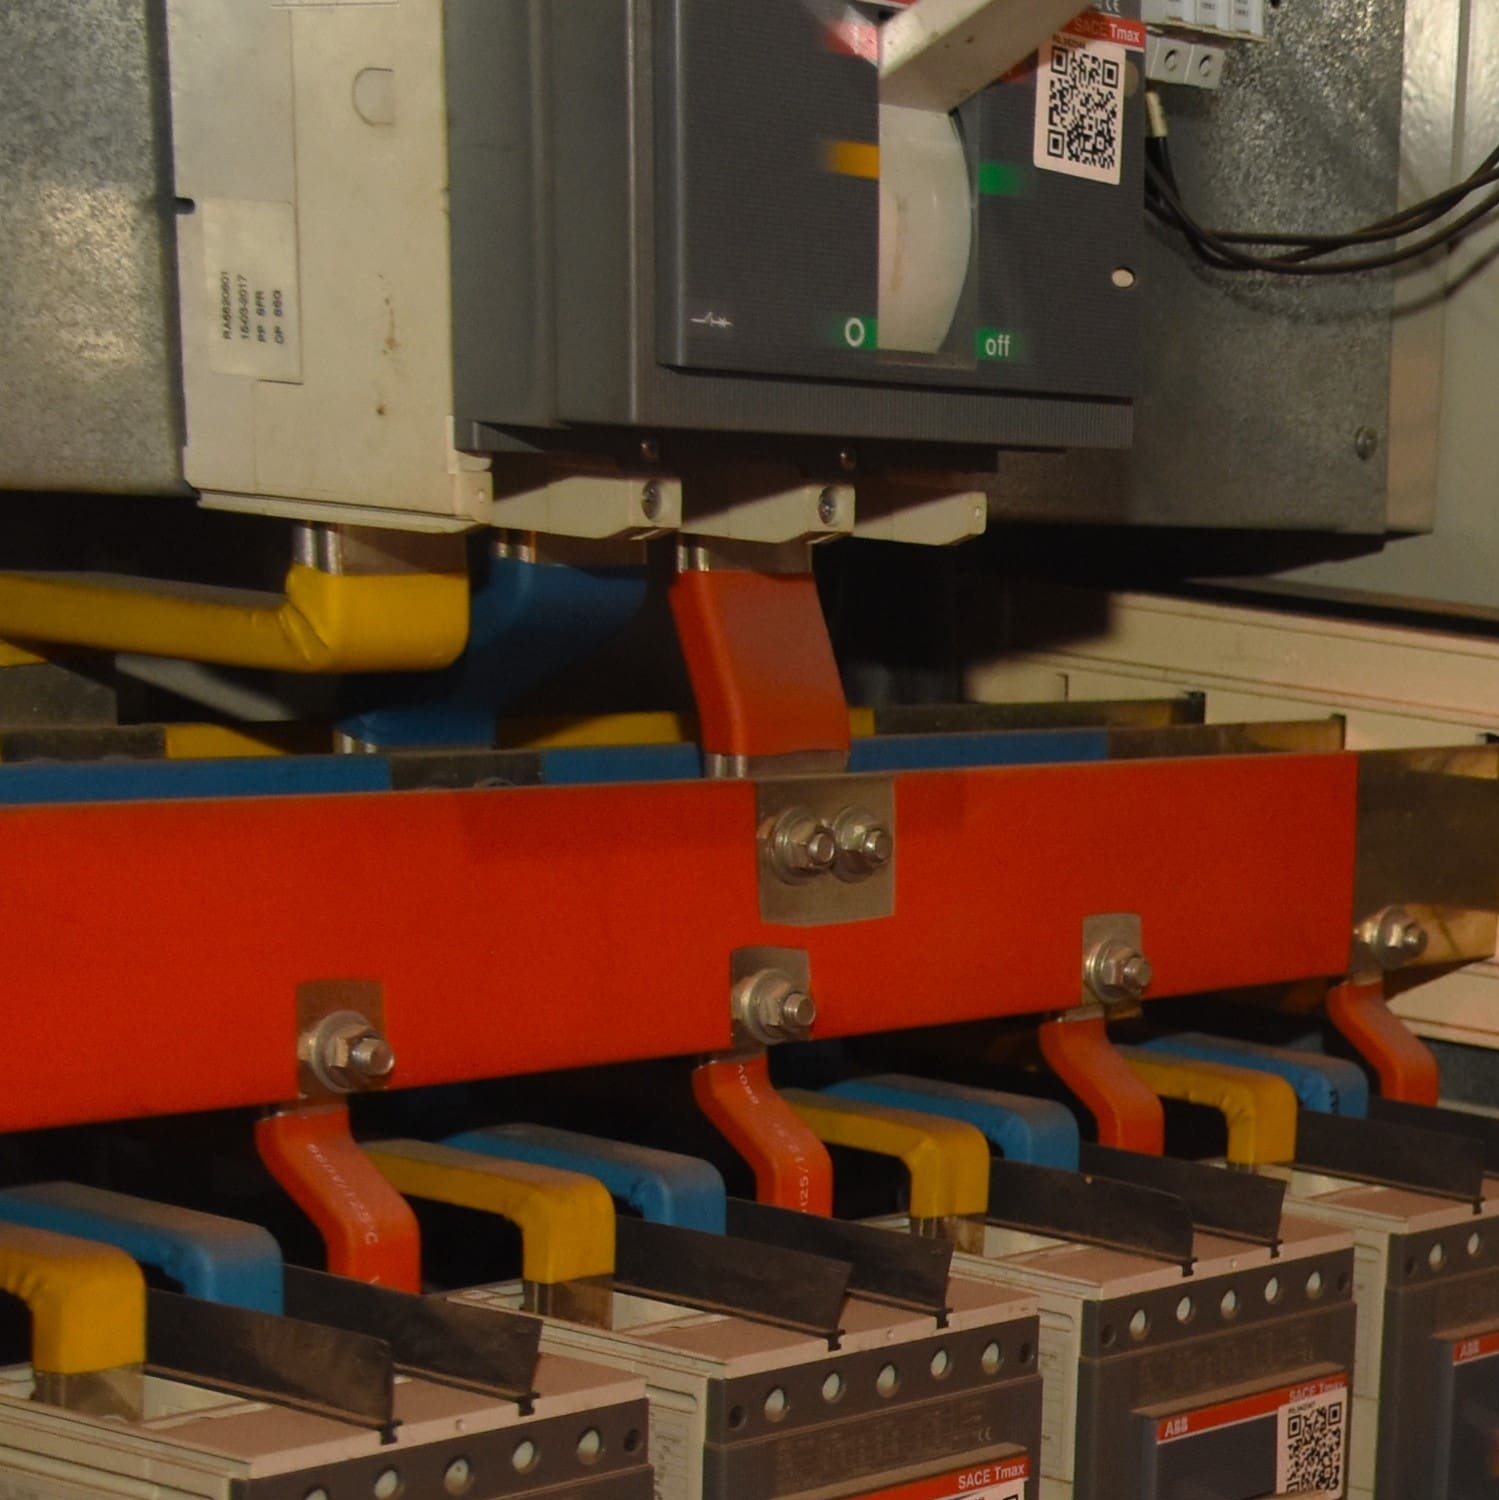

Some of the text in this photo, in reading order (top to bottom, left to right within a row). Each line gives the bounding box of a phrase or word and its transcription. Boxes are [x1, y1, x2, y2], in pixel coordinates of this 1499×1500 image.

[1110, 23, 1140, 43] Tmax
[985, 332, 1010, 358] off
[1165, 1417, 1189, 1438] ABB
[958, 1463, 1025, 1490] SACE Tmax
